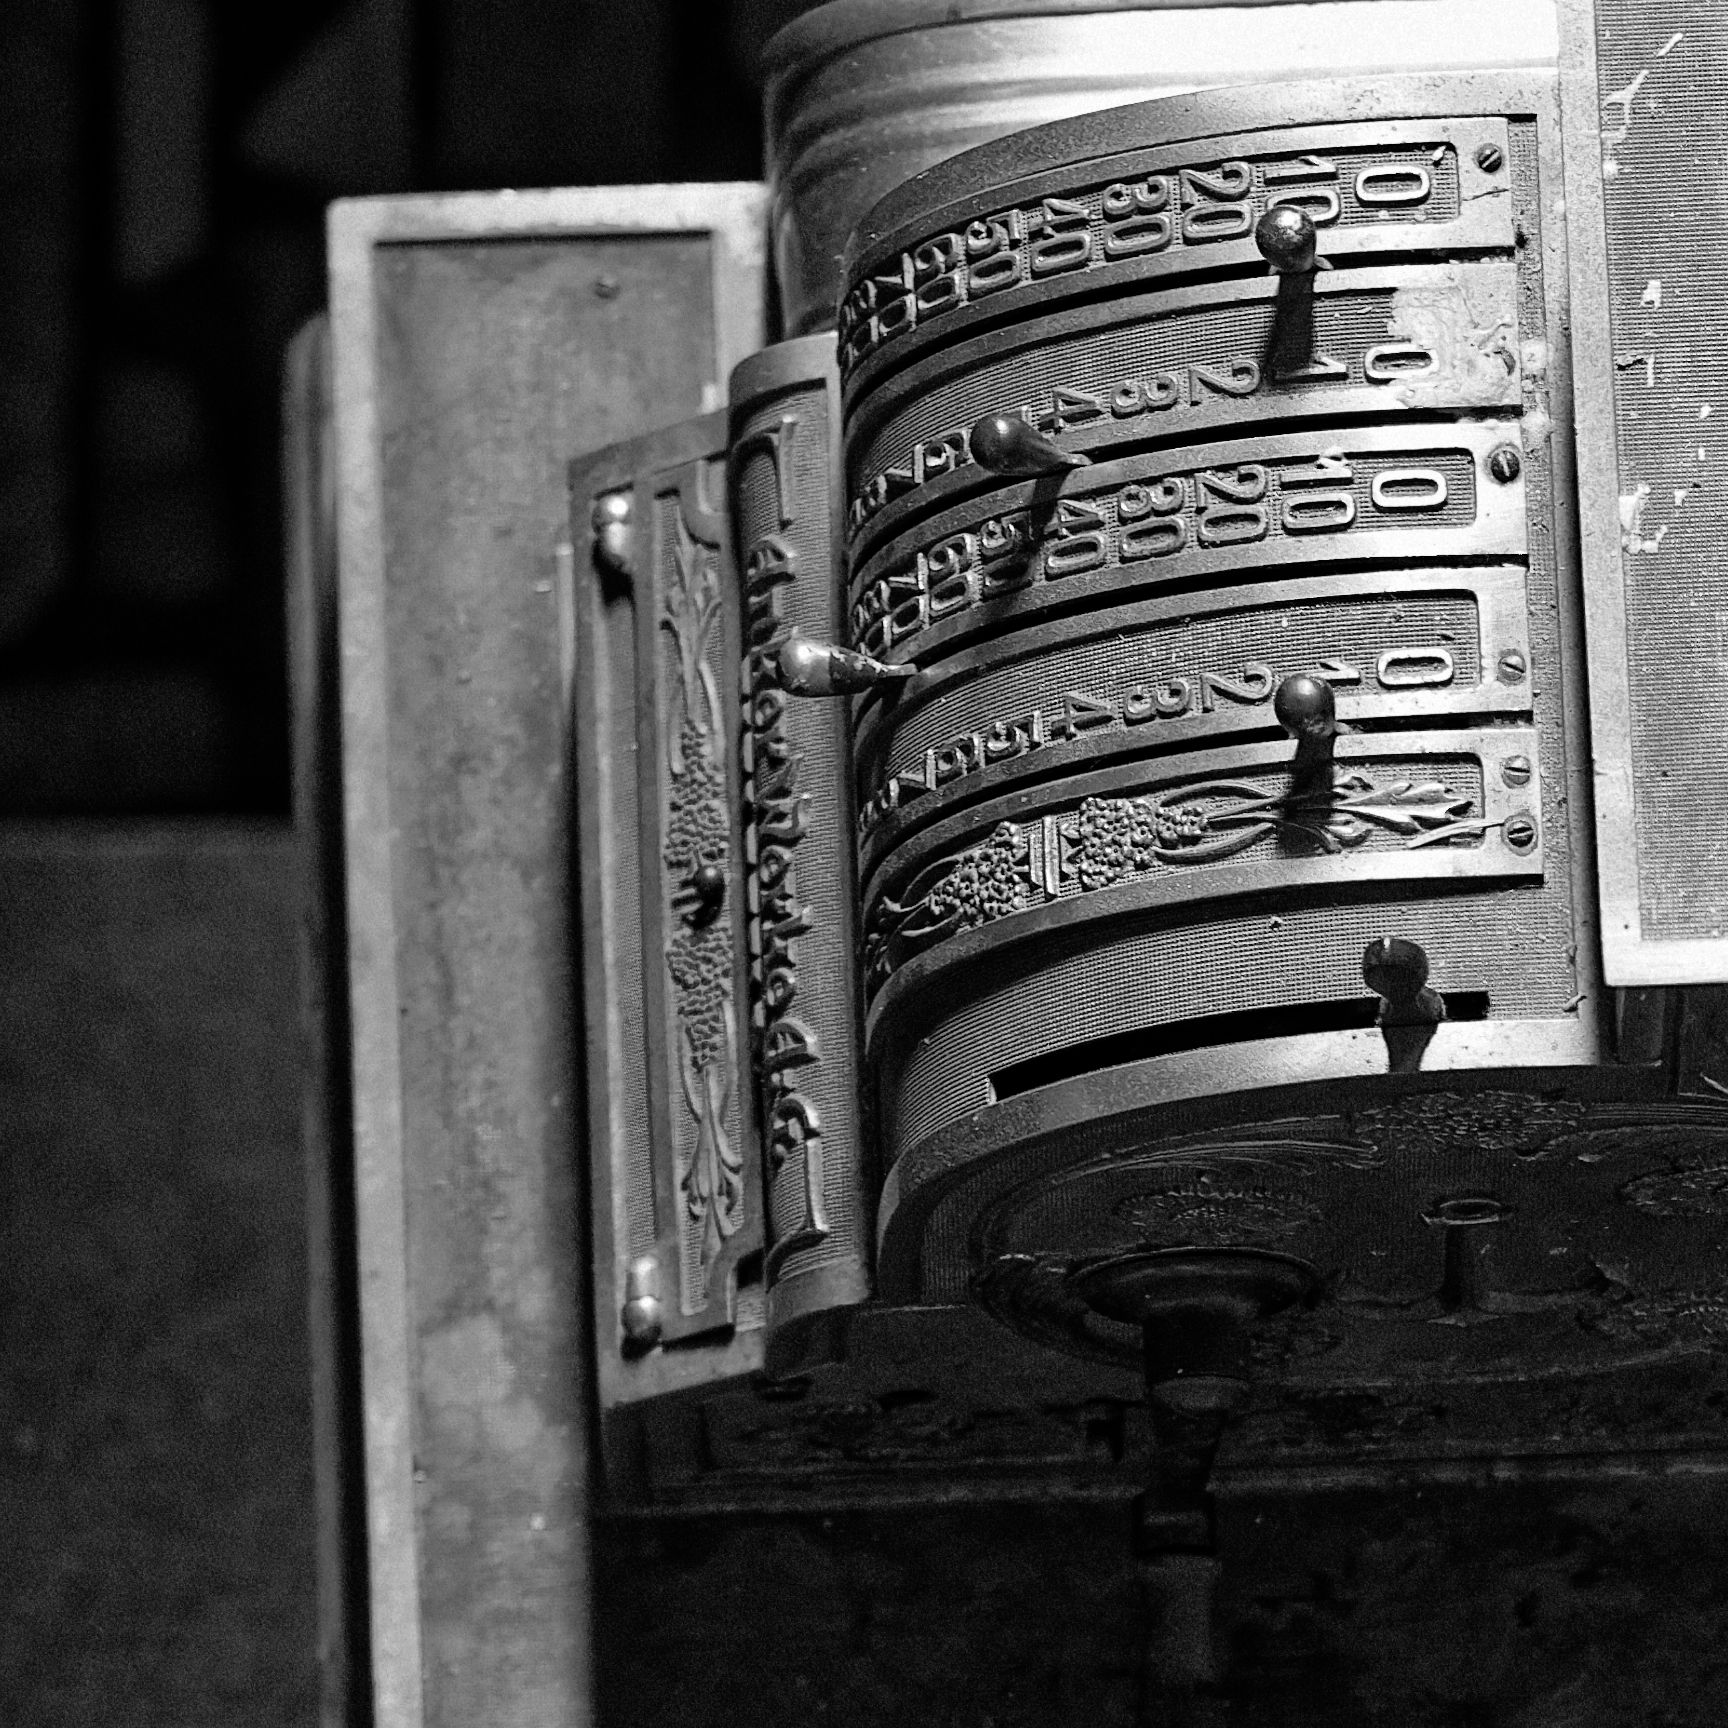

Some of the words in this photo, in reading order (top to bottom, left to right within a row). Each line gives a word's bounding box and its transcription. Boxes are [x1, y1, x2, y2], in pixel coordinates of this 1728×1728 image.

[1180, 161, 1254, 246] 20
[1355, 162, 1432, 208] 0
[1030, 198, 1092, 276] 40
[1103, 174, 1175, 262] 30
[914, 233, 965, 313] 60
[966, 209, 1022, 291] 50
[1189, 358, 1260, 406] 2
[1272, 355, 1348, 384] 1
[1365, 343, 1440, 383] 0
[1039, 385, 1104, 432] 4
[1111, 373, 1180, 419] 3
[1196, 465, 1267, 547] 20
[1280, 449, 1355, 534] 10
[1372, 470, 1447, 512] 0
[1044, 500, 1104, 581] 40
[1119, 478, 1186, 560] 30
[928, 534, 977, 617] 60
[1200, 664, 1273, 712] 2
[1377, 649, 1453, 688] 0
[1051, 691, 1118, 740] 4
[1123, 680, 1191, 726] 3
[986, 711, 1041, 757] 5
